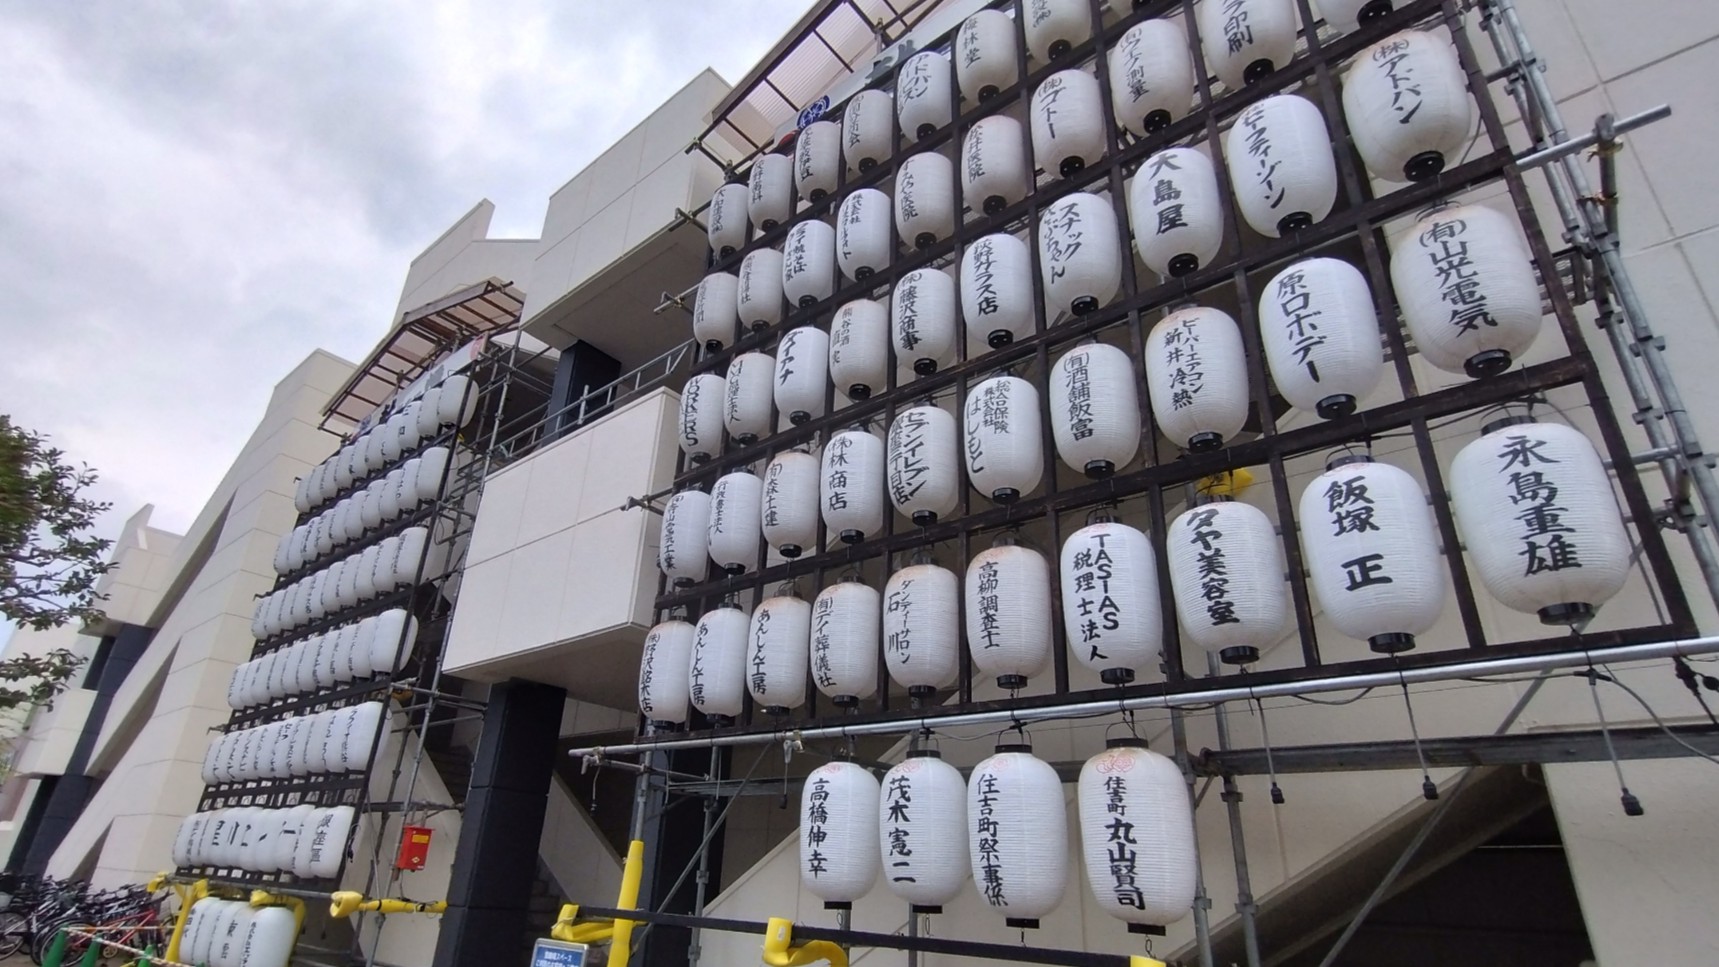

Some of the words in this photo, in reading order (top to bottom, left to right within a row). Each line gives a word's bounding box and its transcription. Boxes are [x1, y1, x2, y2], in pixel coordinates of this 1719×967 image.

[1221, 0, 1253, 58] ラ印刷
[1372, 39, 1422, 124] (株)アドバン
[1059, 201, 1082, 261] スナック
[1149, 153, 1189, 236] 大島屋
[1419, 218, 1498, 338] (有)山光電気
[779, 329, 804, 387] ダイアナ
[1163, 328, 1194, 411] 新井冷熱
[966, 395, 985, 474] はしもと
[982, 386, 996, 428] 株式会社
[993, 379, 1012, 435] 総合保険
[828, 435, 853, 511] (株)林商店
[903, 411, 930, 498] セブンイレブン
[1497, 434, 1582, 579] 永島重雄
[976, 561, 1001, 650] 高柳調査士
[1072, 547, 1110, 662] 税理士法人
[691, 622, 709, 706] あんしん工房
[751, 607, 771, 696] あんしん工房
[807, 777, 831, 879] 高橋伸幸
[886, 774, 917, 884] 茂木憲二
[976, 772, 1009, 907] 住吉町祭事係
